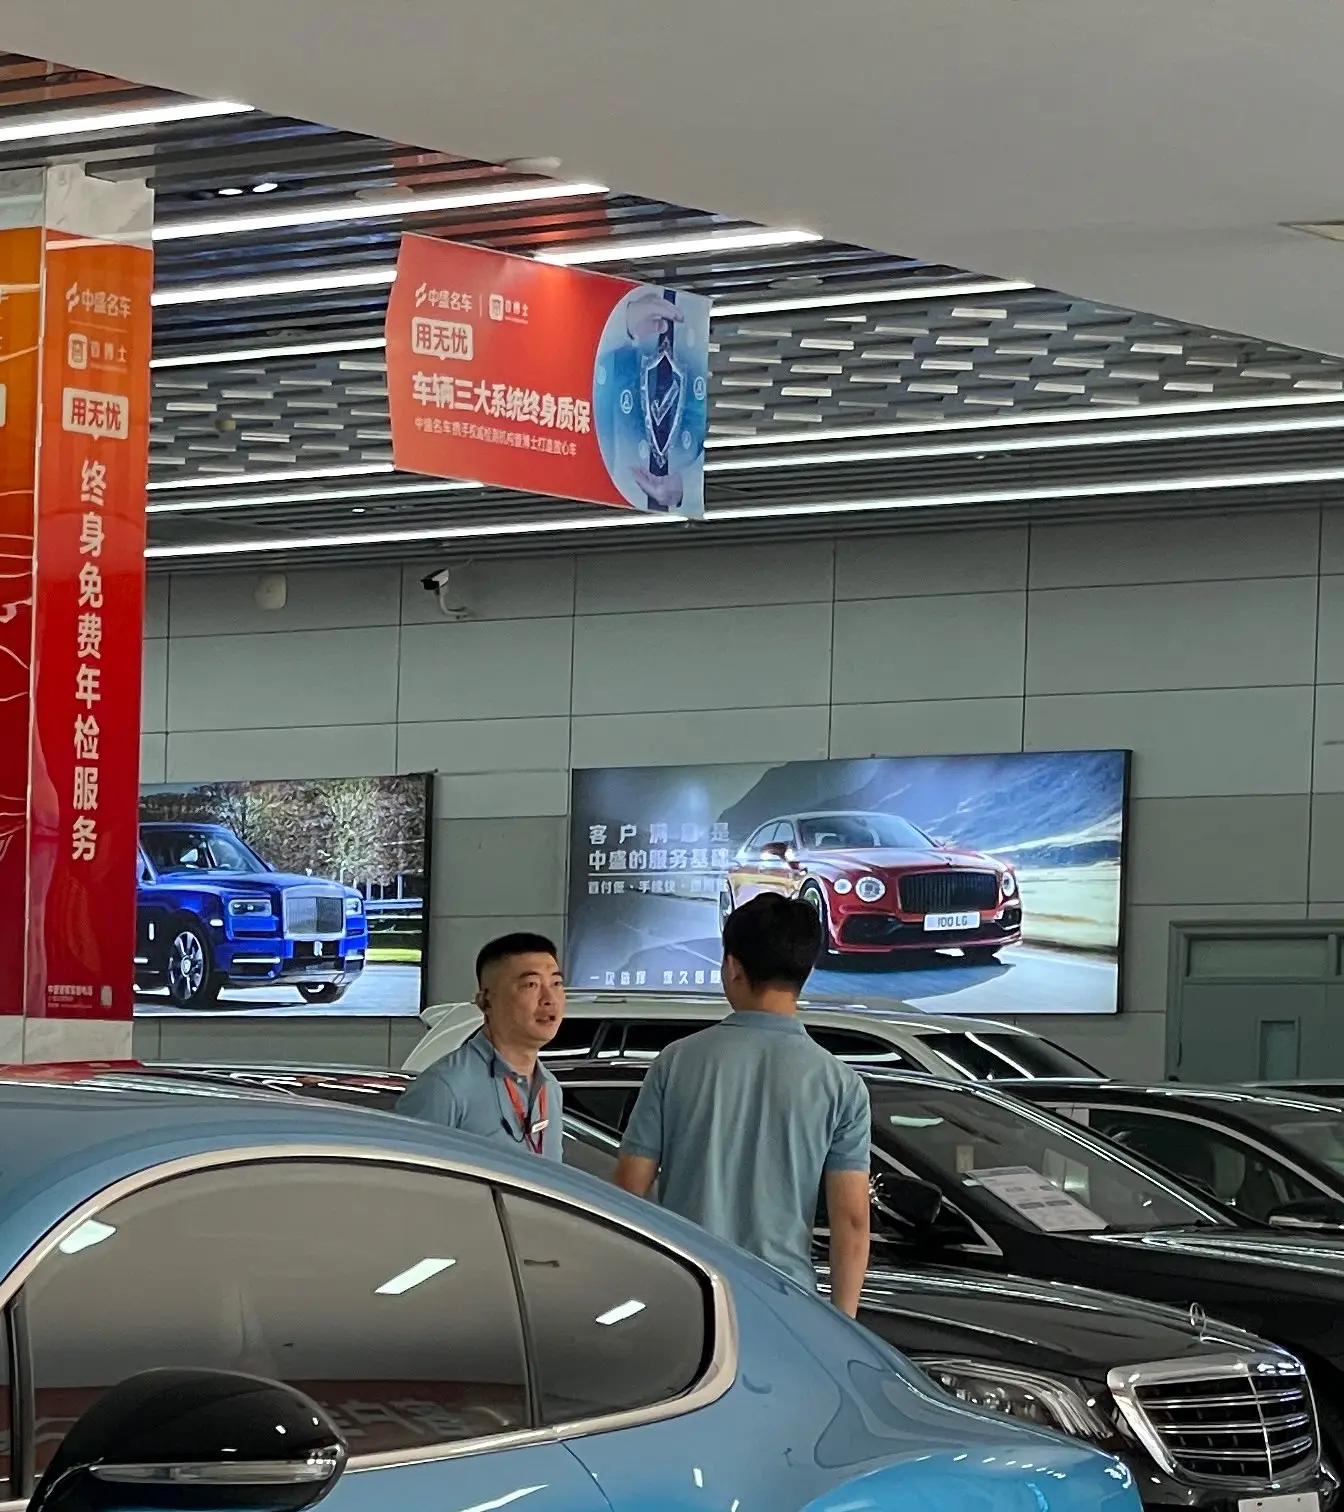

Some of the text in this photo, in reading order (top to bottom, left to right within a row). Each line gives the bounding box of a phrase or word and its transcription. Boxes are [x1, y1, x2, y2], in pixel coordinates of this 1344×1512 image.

[415, 322, 468, 355] 用无忧
[70, 397, 122, 432] 用无忧
[412, 371, 591, 434] 车辆三大系统终身质保
[71, 459, 107, 861] 终身免费年检服务
